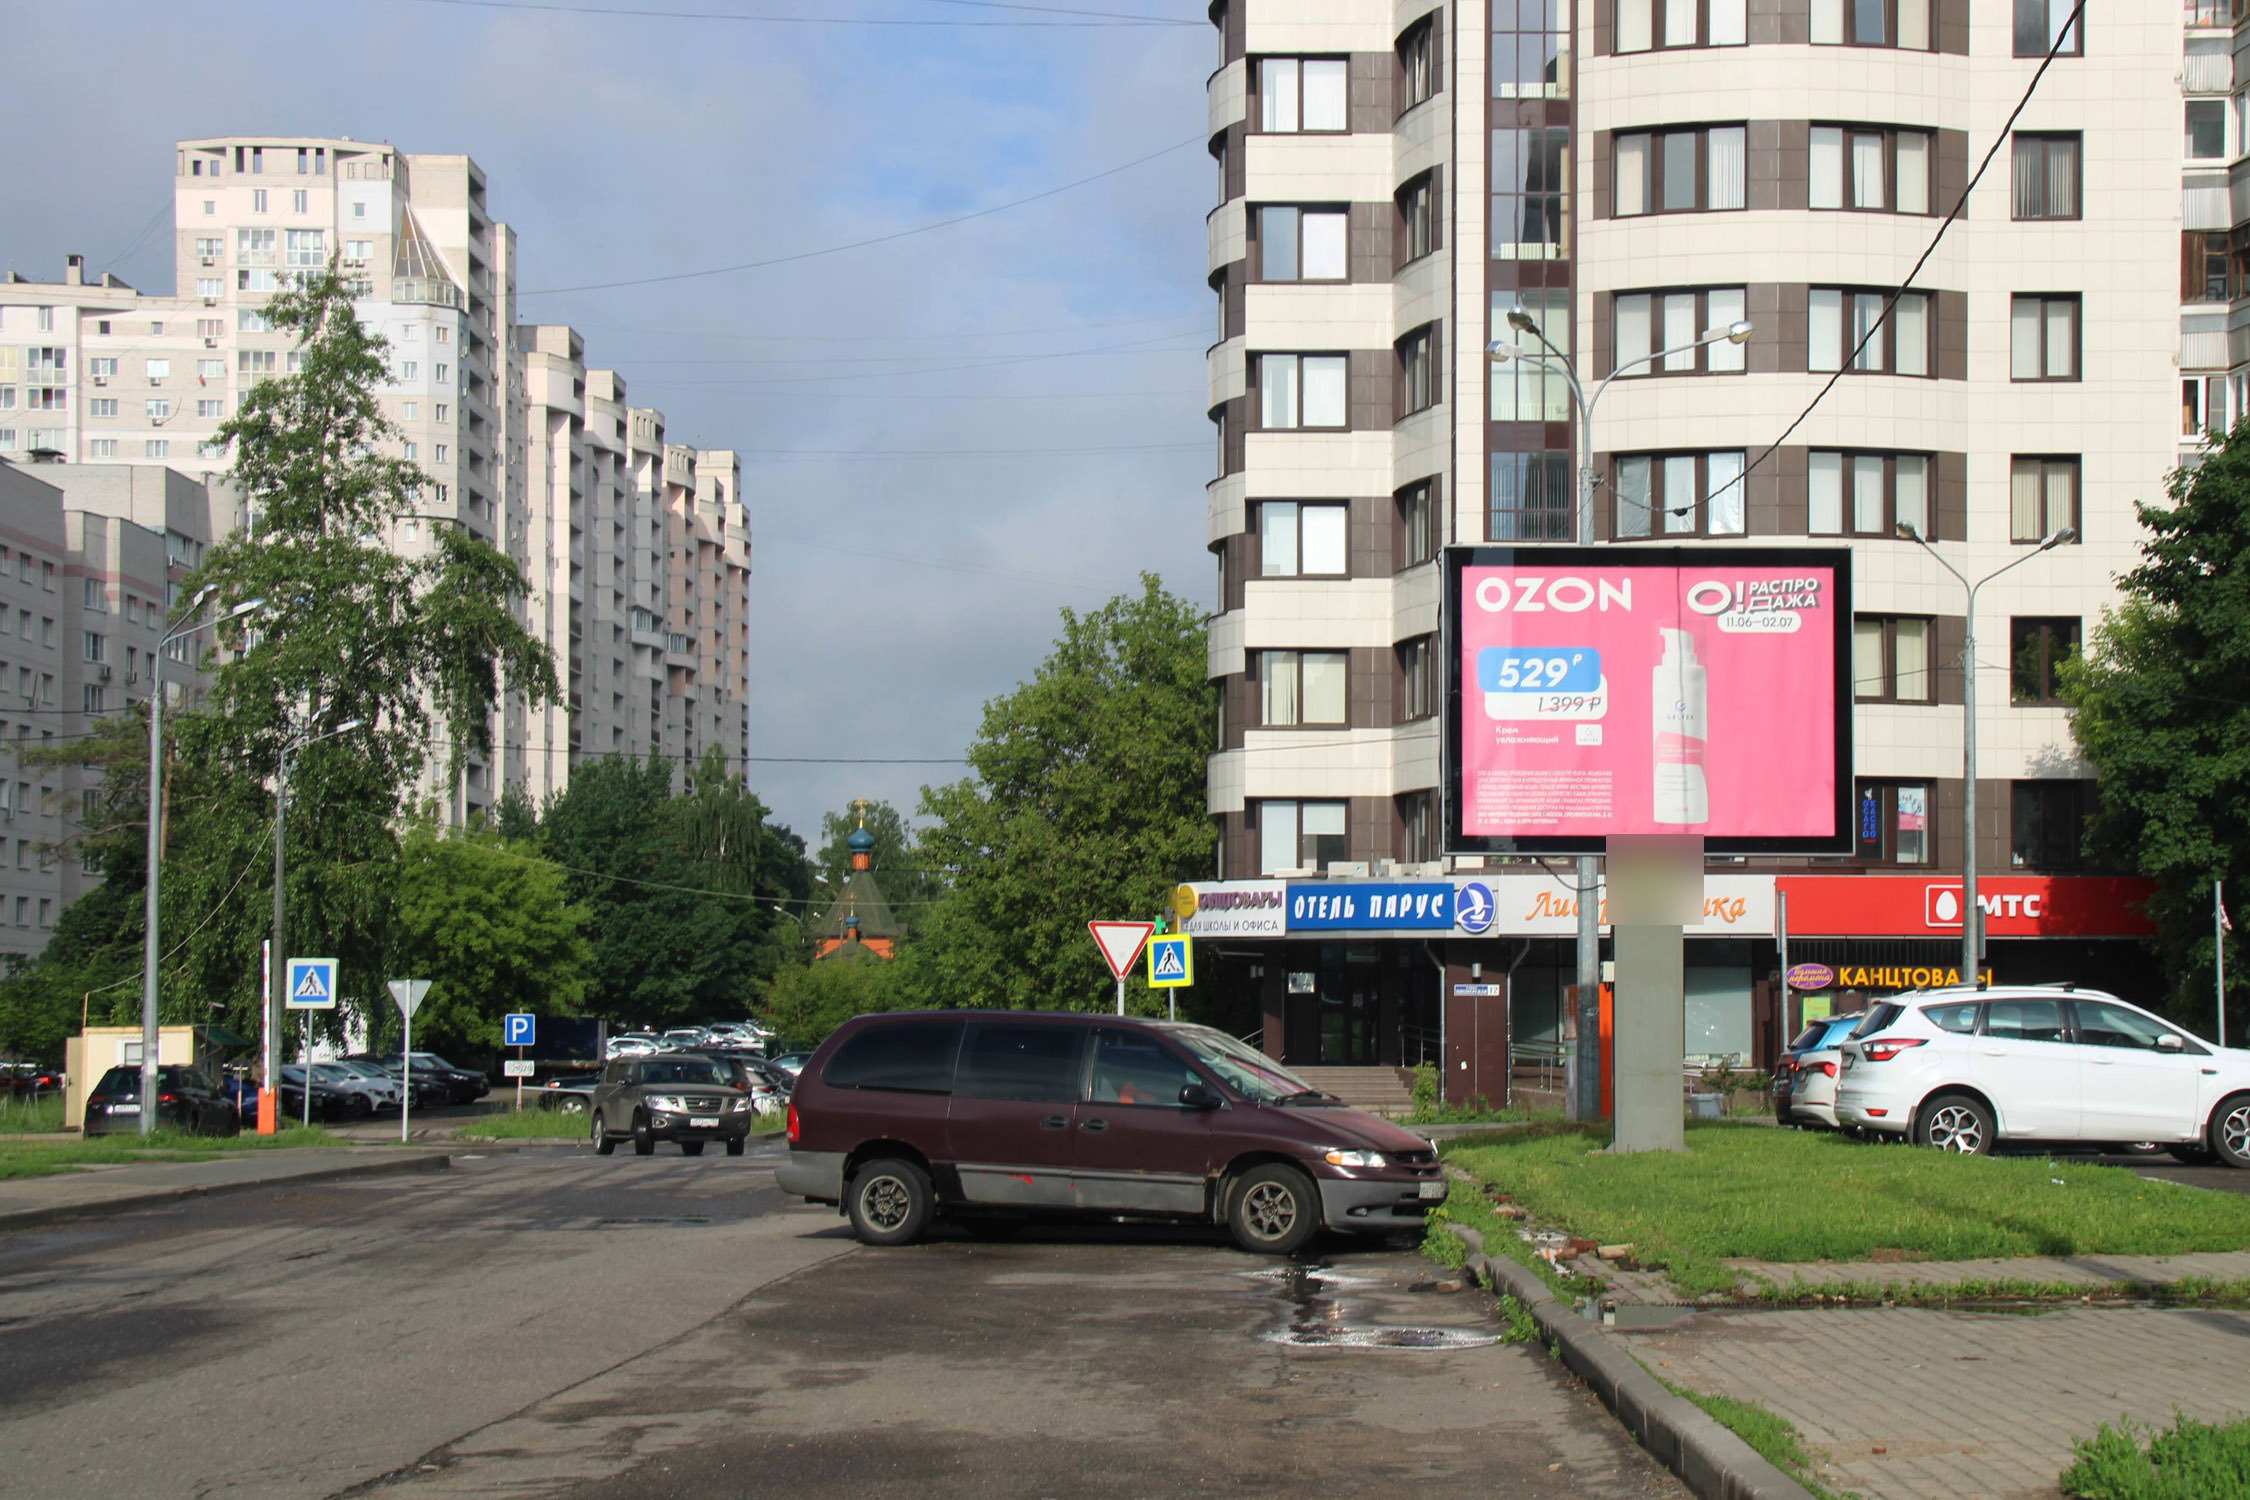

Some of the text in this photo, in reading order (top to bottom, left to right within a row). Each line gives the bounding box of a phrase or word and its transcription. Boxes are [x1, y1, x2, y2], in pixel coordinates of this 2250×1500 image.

[1476, 577, 1632, 613] OZON
[1748, 578, 1818, 596] РАСПРО
[1747, 593, 1817, 612] ДАЖА
[1498, 658, 1568, 688] 529
[1495, 735, 1560, 746] увлажняющий
[1294, 893, 1444, 920] ОТЕЛЬ ПАРУС
[1977, 894, 2041, 917] МТС
[1203, 921, 1231, 932] ШКОЛЫ
[1233, 921, 1240, 932] И
[1242, 919, 1279, 932] ОФИСА
[512, 1018, 528, 1042] P
